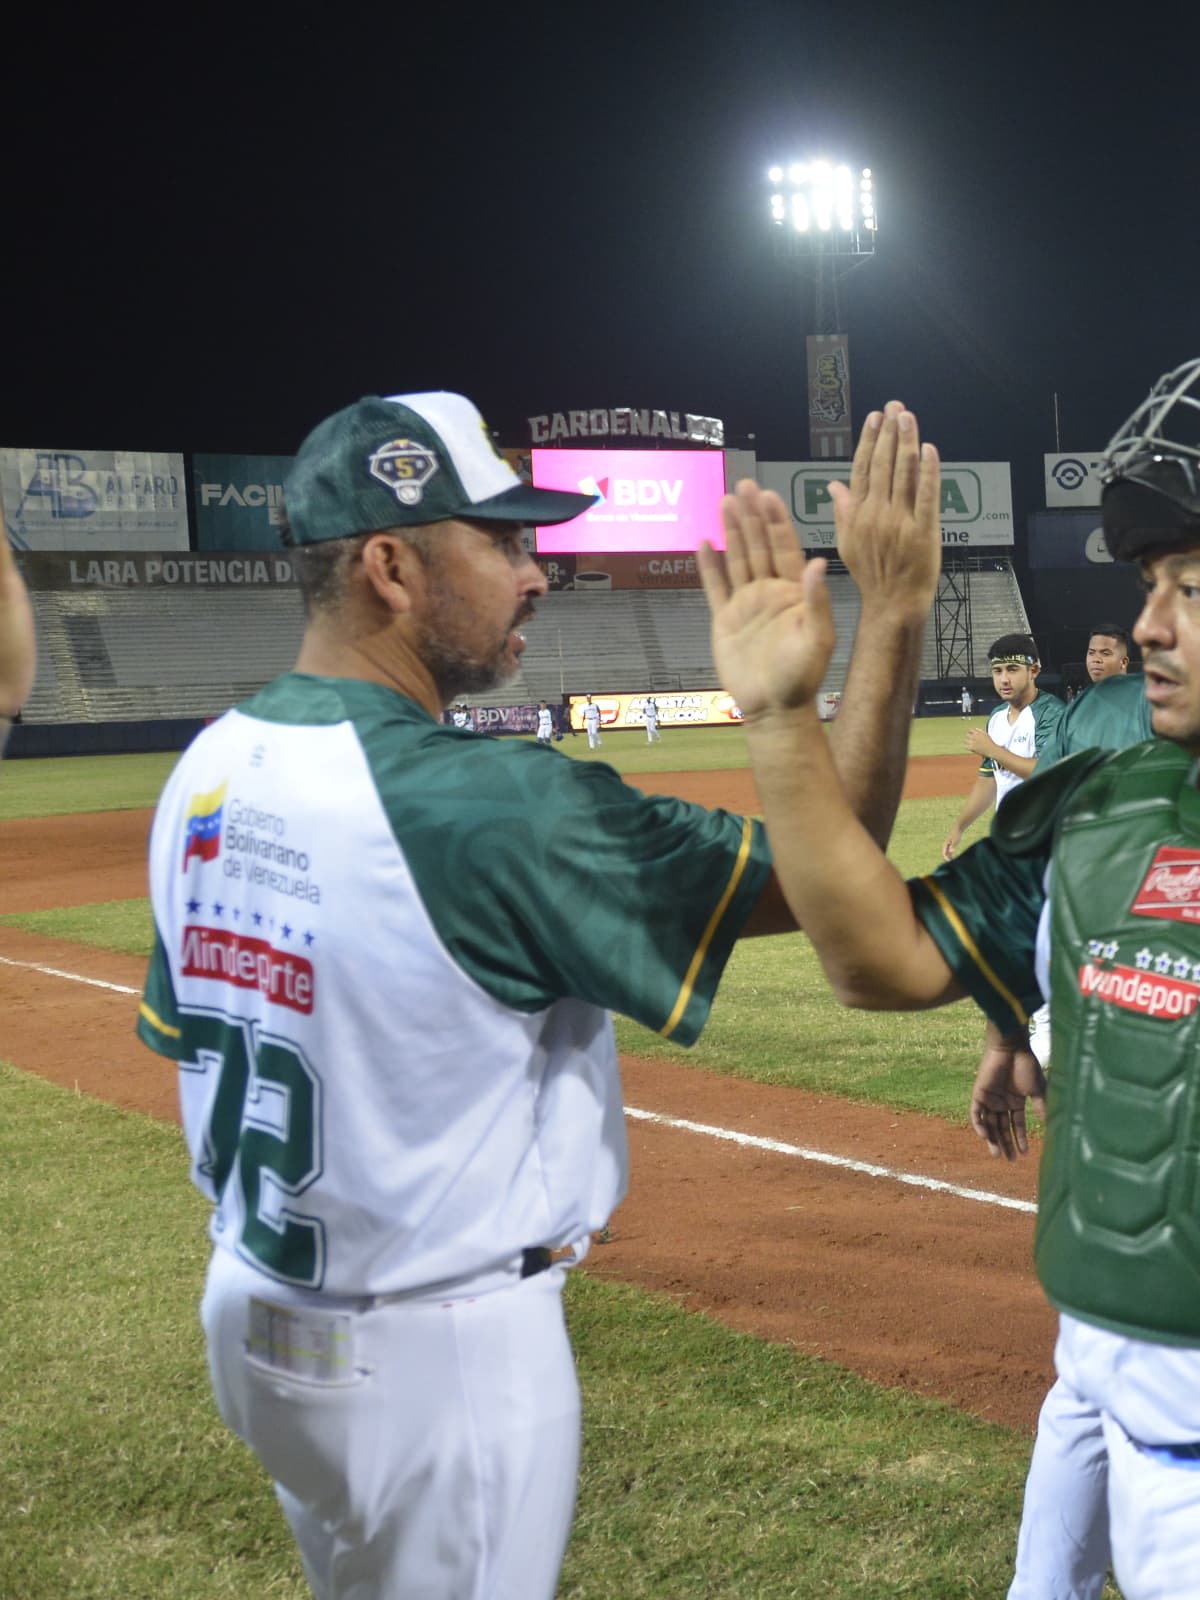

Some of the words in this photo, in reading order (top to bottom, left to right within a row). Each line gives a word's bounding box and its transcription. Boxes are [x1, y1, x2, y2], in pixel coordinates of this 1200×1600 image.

[613, 480, 683, 506] BDV
[70, 560, 139, 583] LARA
[145, 560, 273, 583] POTENCIA
[477, 708, 509, 724] BDV
